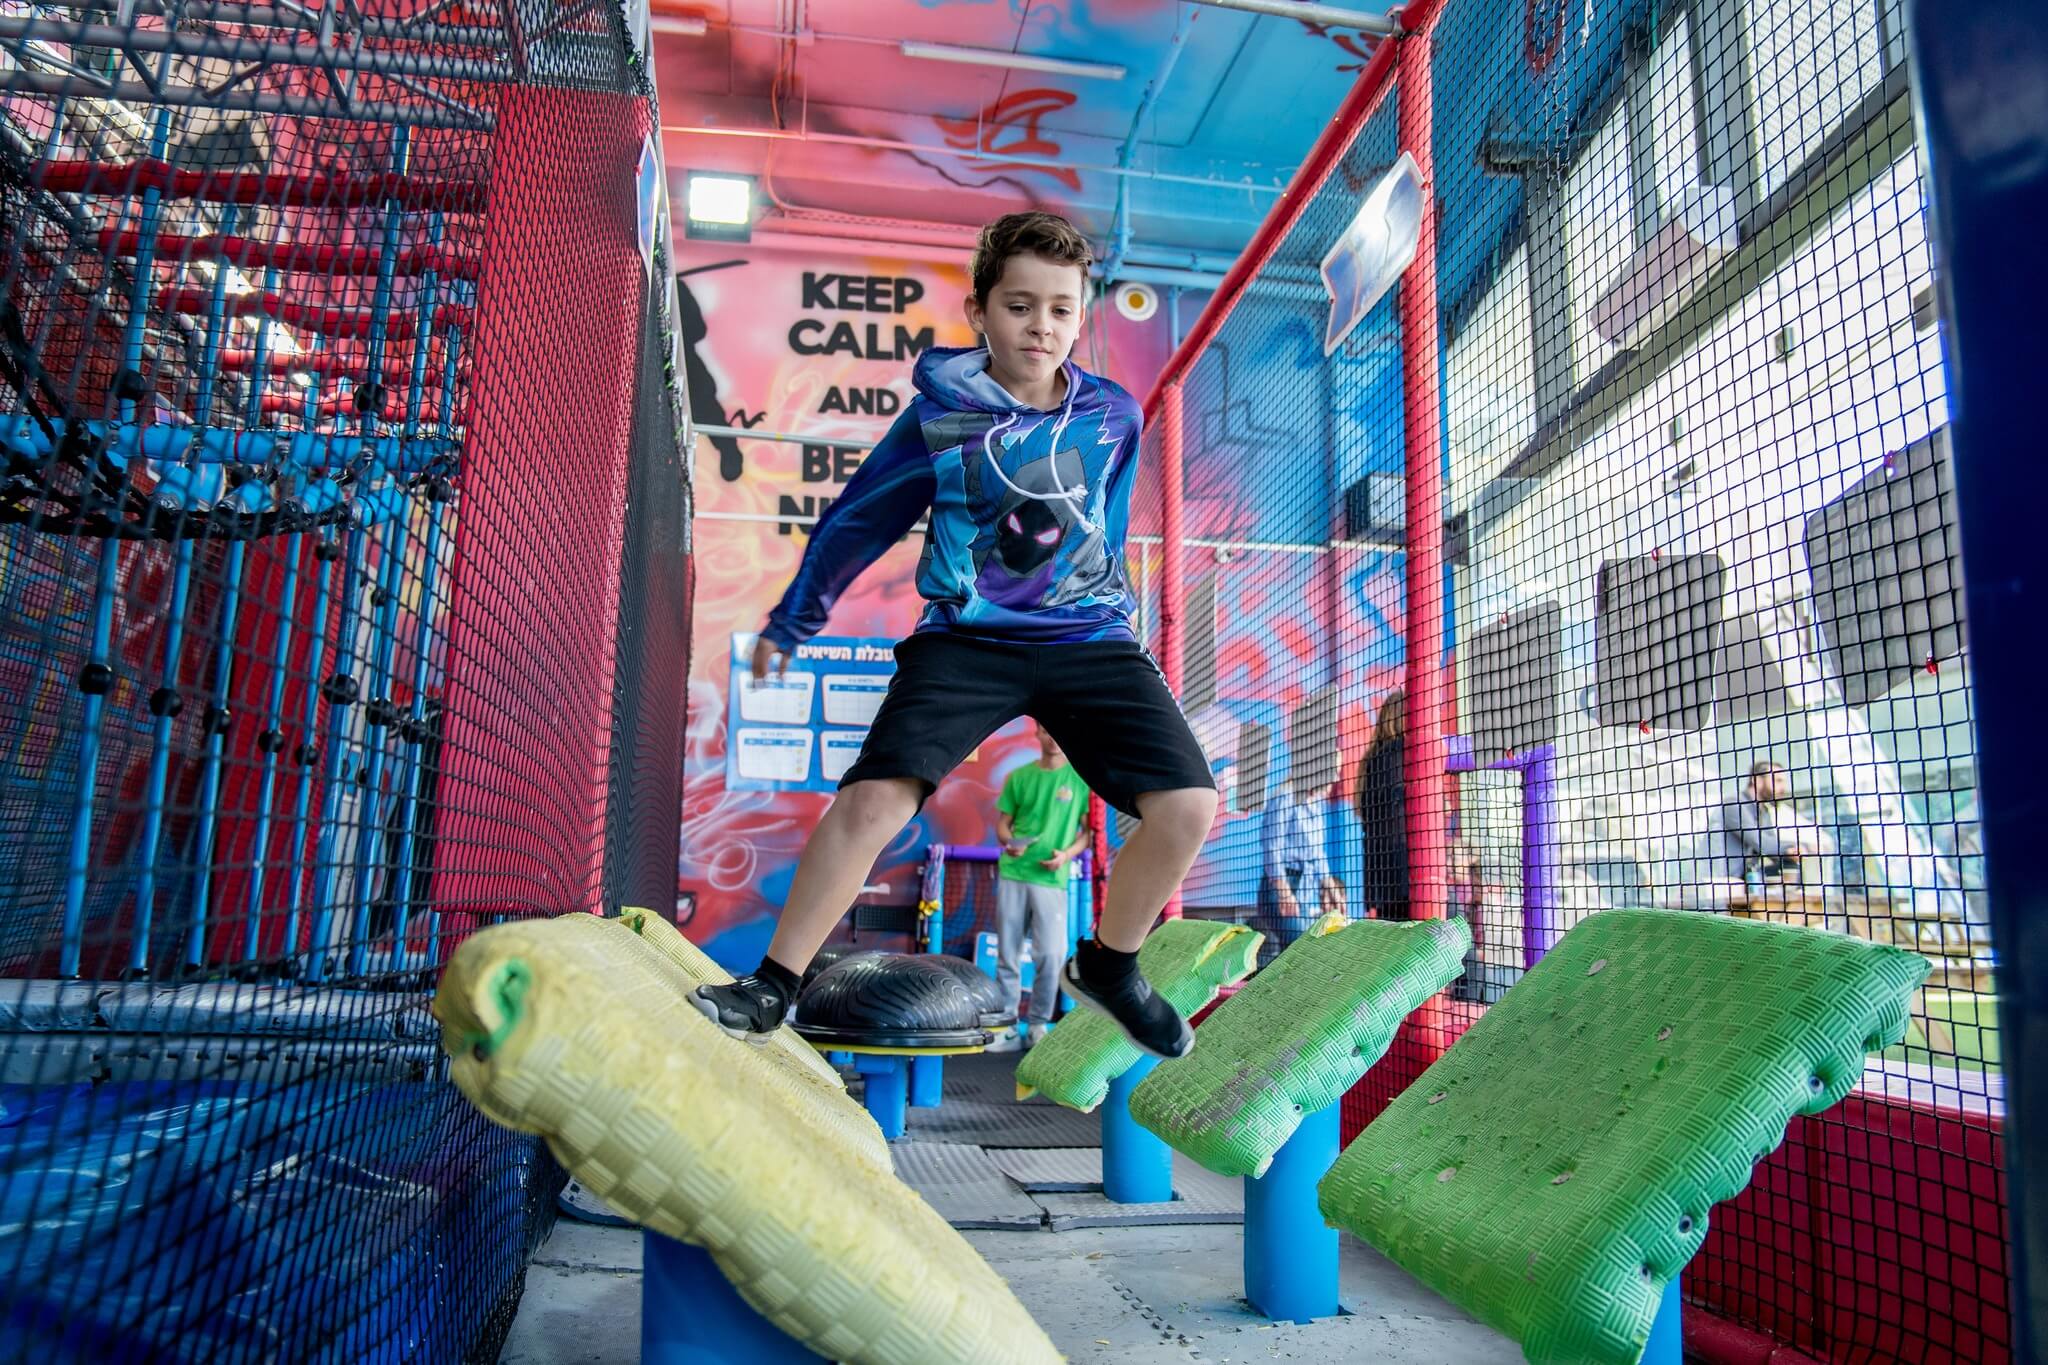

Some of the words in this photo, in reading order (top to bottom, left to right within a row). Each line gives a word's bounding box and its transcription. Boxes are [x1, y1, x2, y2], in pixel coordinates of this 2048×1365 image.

[801, 272, 925, 314] KEEP
[788, 319, 935, 361] CALM
[818, 386, 900, 416] AND
